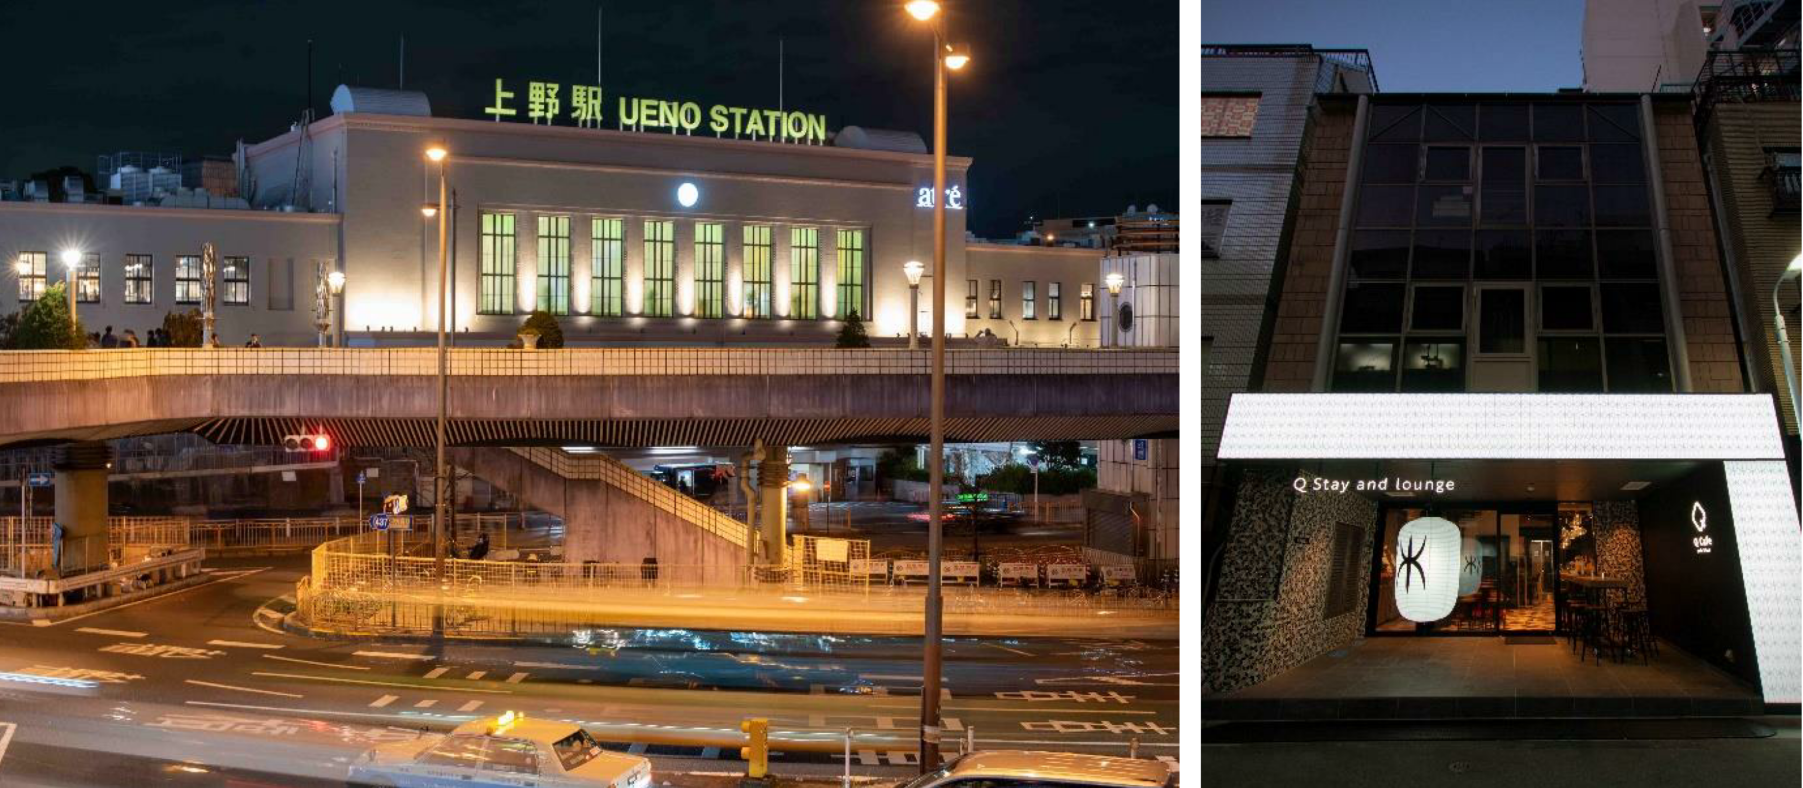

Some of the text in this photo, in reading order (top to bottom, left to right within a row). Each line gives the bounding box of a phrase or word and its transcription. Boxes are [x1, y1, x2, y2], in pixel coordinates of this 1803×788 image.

[484, 78, 603, 120] 上野駅
[619, 97, 827, 140] UENO STATION
[1292, 477, 1455, 493] Q Stay and lounge
[375, 517, 389, 528] 437
